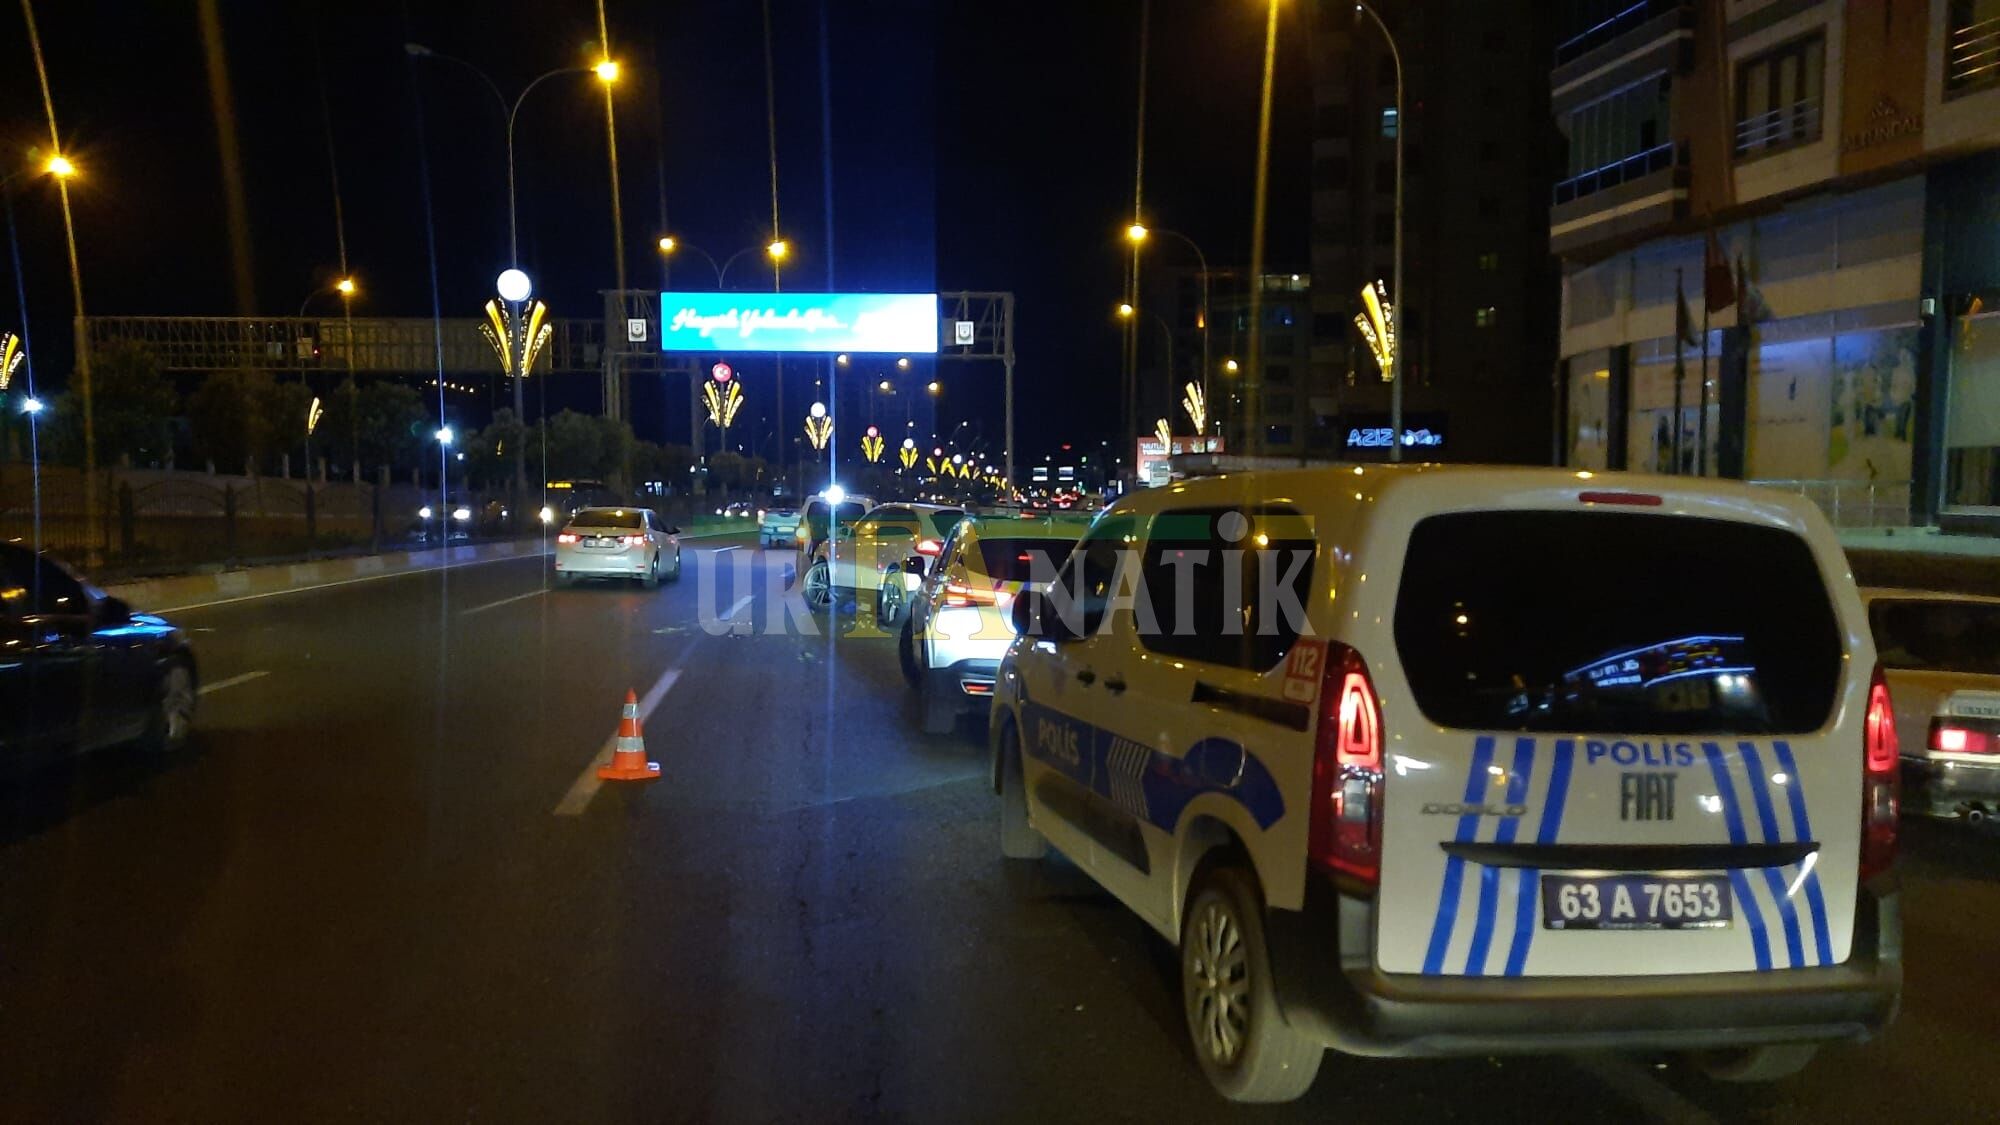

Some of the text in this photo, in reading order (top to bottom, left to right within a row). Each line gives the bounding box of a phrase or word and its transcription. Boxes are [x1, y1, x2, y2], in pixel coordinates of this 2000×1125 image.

[1292, 646, 1319, 677] 112
[1585, 737, 1695, 767] POLİS
[1621, 773, 1677, 821] FIAT
[1560, 883, 1721, 919] 63 A 7653
